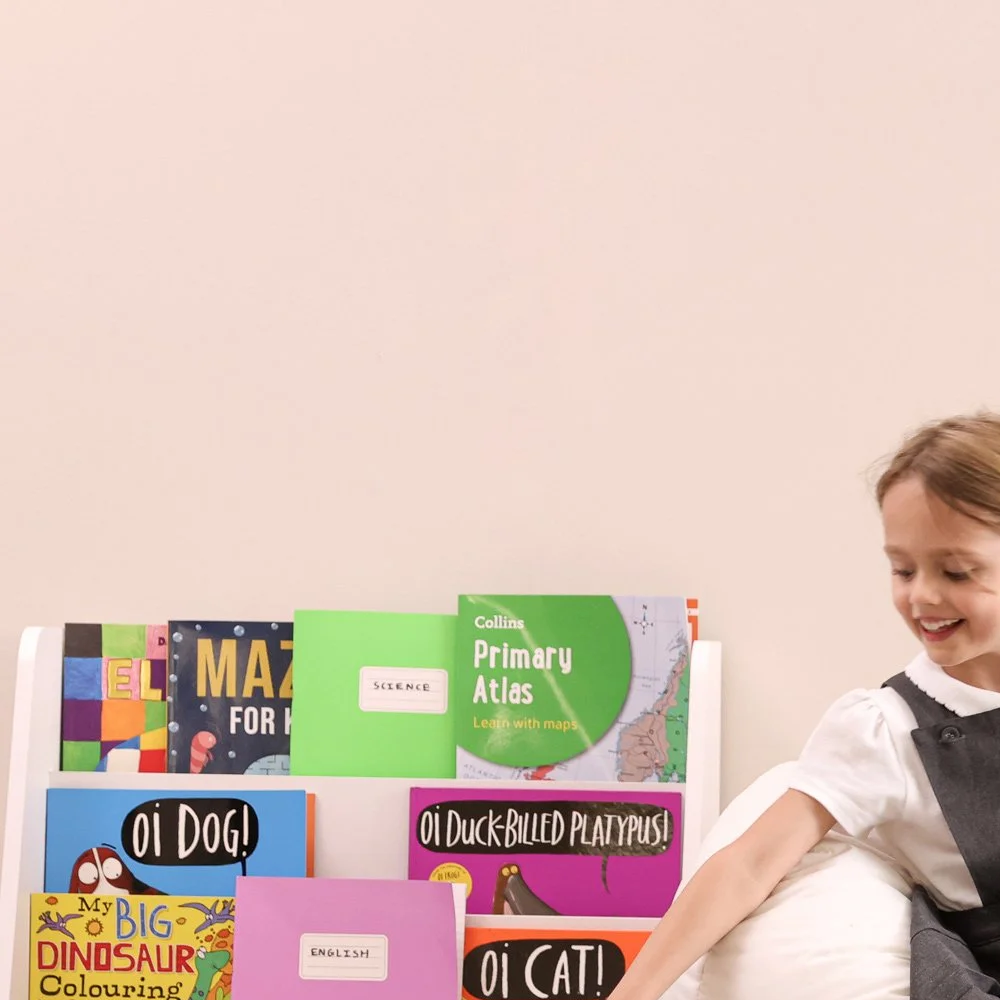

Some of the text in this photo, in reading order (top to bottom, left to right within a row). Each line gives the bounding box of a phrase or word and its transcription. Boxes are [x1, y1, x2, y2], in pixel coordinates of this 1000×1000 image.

[474, 615, 525, 629] Collins
[473, 639, 573, 675] Primary
[373, 681, 431, 692] SCIENCE
[472, 674, 534, 705] Atlas
[229, 706, 275, 735] FOR
[473, 716, 579, 732] Learn with maps
[178, 803, 249, 859] DOG!
[569, 809, 669, 851] PLATYPUS!
[78, 897, 173, 940] My BIG
[36, 941, 196, 974] DINOSAUR
[310, 948, 370, 960] ENGLISH
[524, 944, 604, 999] CAT!
